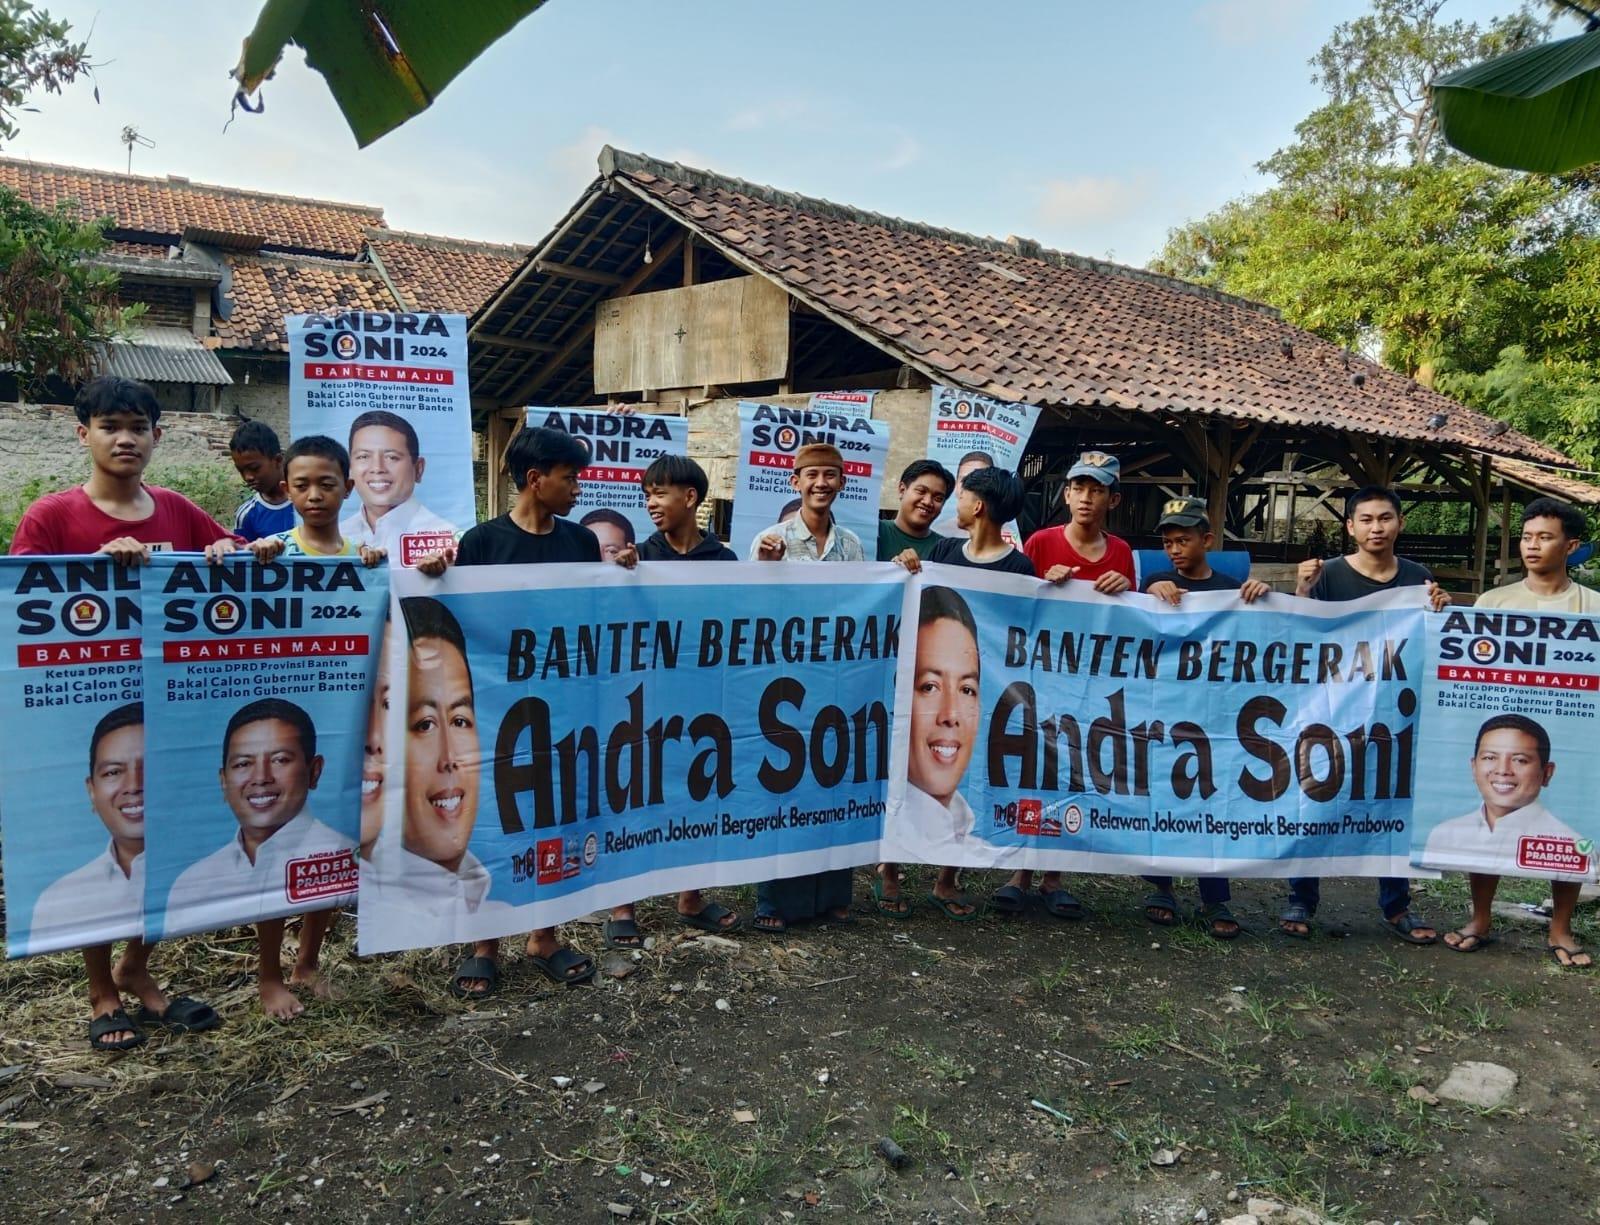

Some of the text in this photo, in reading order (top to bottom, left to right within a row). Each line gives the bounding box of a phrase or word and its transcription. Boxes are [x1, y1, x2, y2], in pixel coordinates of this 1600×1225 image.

[303, 313, 450, 337] ANDRA
[304, 331, 448, 361] SONI 2024
[315, 367, 444, 382] BANTEN MAJU
[348, 382, 372, 390] DPRD
[373, 384, 408, 392] Provinsi
[307, 391, 453, 404] Bakal Calon Gubernur Banten
[307, 400, 453, 412] Bakal Calon Gubernur Banten
[752, 404, 875, 434] ANDRA
[938, 400, 1020, 428] SONI 2024
[543, 411, 672, 440] ANDRA
[943, 423, 986, 431] BANTEN
[752, 424, 871, 452] SONI 2024
[571, 435, 630, 463] NI
[758, 456, 864, 474] BANT JU
[621, 471, 641, 480] MA
[750, 476, 773, 484] Bakal
[774, 478, 792, 486] Calo
[596, 492, 637, 500] Gubernur
[749, 484, 772, 492] Bakal
[840, 492, 867, 501] Banten
[595, 500, 637, 508] Gubernur
[408, 539, 453, 547] KADER
[162, 561, 365, 593] ANDRA
[17, 593, 142, 637] SON
[163, 594, 362, 635] SONI 2024
[1440, 611, 1600, 642] ANDRA
[37, 644, 142, 661] BANTE
[180, 640, 355, 658] BANTEN MAJU
[506, 614, 901, 682] BANTEN BERGERAK
[1005, 626, 1409, 684] BANTEN BERGERAK
[1439, 636, 1596, 666] SONI 2024
[46, 668, 85, 679] Ketua
[88, 665, 126, 676] DPRD
[187, 659, 348, 675] Ketua DPRD Provinsi Banten
[24, 682, 69, 695] Bakal
[73, 679, 117, 692] Calon
[167, 671, 366, 689] Bakal Calon Gubernur Banten
[1449, 669, 1589, 687] BANTEN MAJU
[25, 695, 69, 708] Bakal
[73, 692, 117, 704] Calon
[167, 682, 365, 702] Bakal Calon Gubernur Banten
[1453, 683, 1581, 699] Ketua DPRD Provinsi Banten
[1438, 691, 1596, 710] Bakal Calon Gubernur Banten
[1438, 700, 1595, 718] Bakal Calon Gubernur Banten
[987, 681, 1417, 803] Andra Soni
[493, 676, 894, 835] Andra Son
[605, 827, 663, 855] Relawan
[664, 813, 718, 842] Jokowi
[722, 808, 787, 839] Bergerak
[790, 800, 846, 828] Bersama
[848, 795, 887, 819] Prabo
[1090, 808, 1150, 831] Relawan
[1151, 811, 1203, 834] Jokowi
[1206, 814, 1274, 841] Bergerak
[1277, 814, 1339, 837] Bersama
[1342, 814, 1405, 834] Prabowo
[1526, 841, 1574, 854] KADER
[1525, 851, 1581, 864] PRABOWO
[296, 859, 351, 877] KADER
[296, 869, 359, 888] PRABOWO
